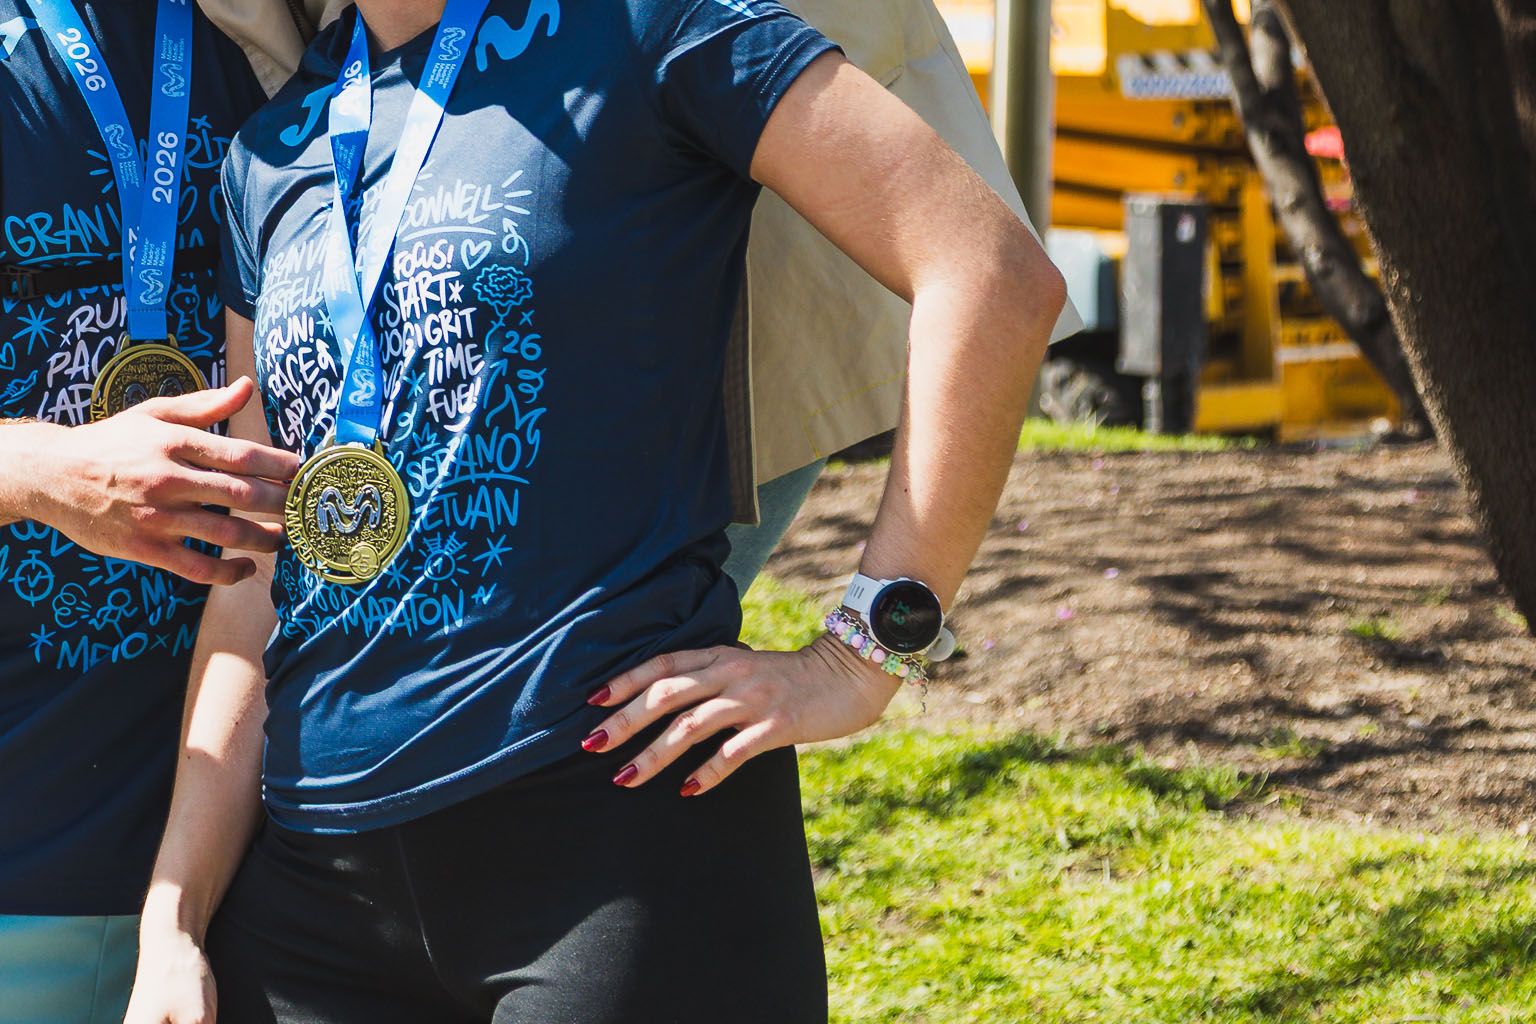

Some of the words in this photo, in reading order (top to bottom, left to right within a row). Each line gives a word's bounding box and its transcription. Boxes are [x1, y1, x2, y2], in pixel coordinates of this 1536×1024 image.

[56, 27, 107, 92] 2026
[151, 131, 178, 204] 2026
[4, 203, 109, 258] GRAN
[265, 311, 314, 363] RUN!
[502, 331, 542, 361] 26
